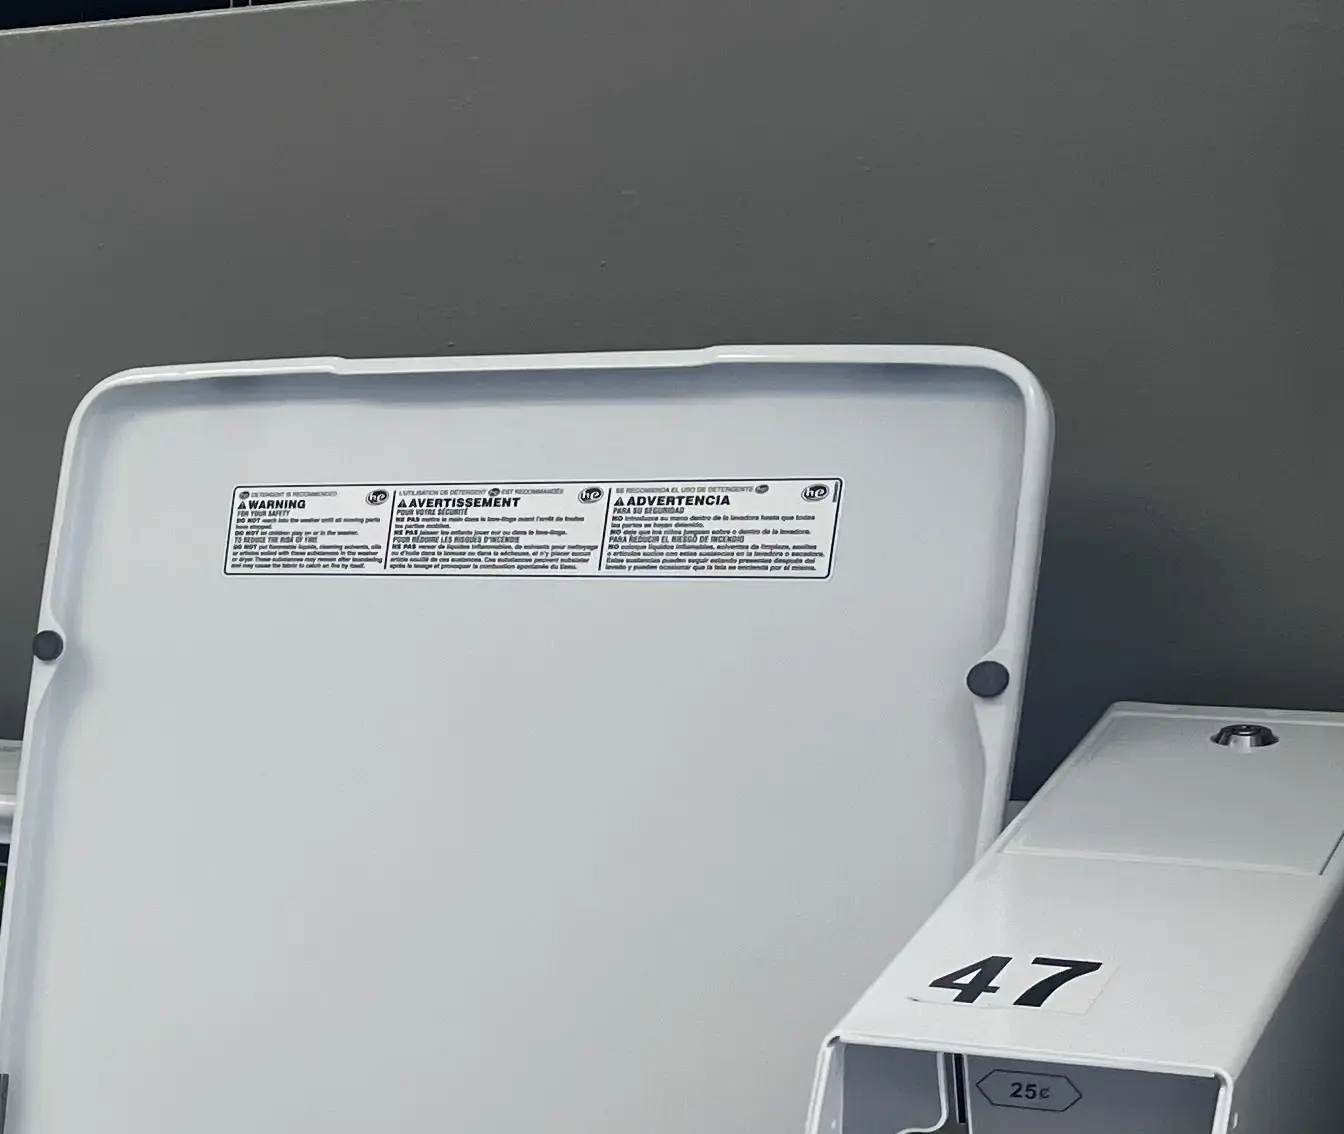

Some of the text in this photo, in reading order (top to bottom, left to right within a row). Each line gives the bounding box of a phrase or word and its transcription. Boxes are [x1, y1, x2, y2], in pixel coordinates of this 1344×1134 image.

[248, 499, 306, 510] WARNING
[408, 496, 521, 508] AVERTISSEMENT
[626, 495, 731, 507] ADVERTENCIA
[928, 955, 1103, 1008] 47
[1009, 1082, 1051, 1100] 25¢
